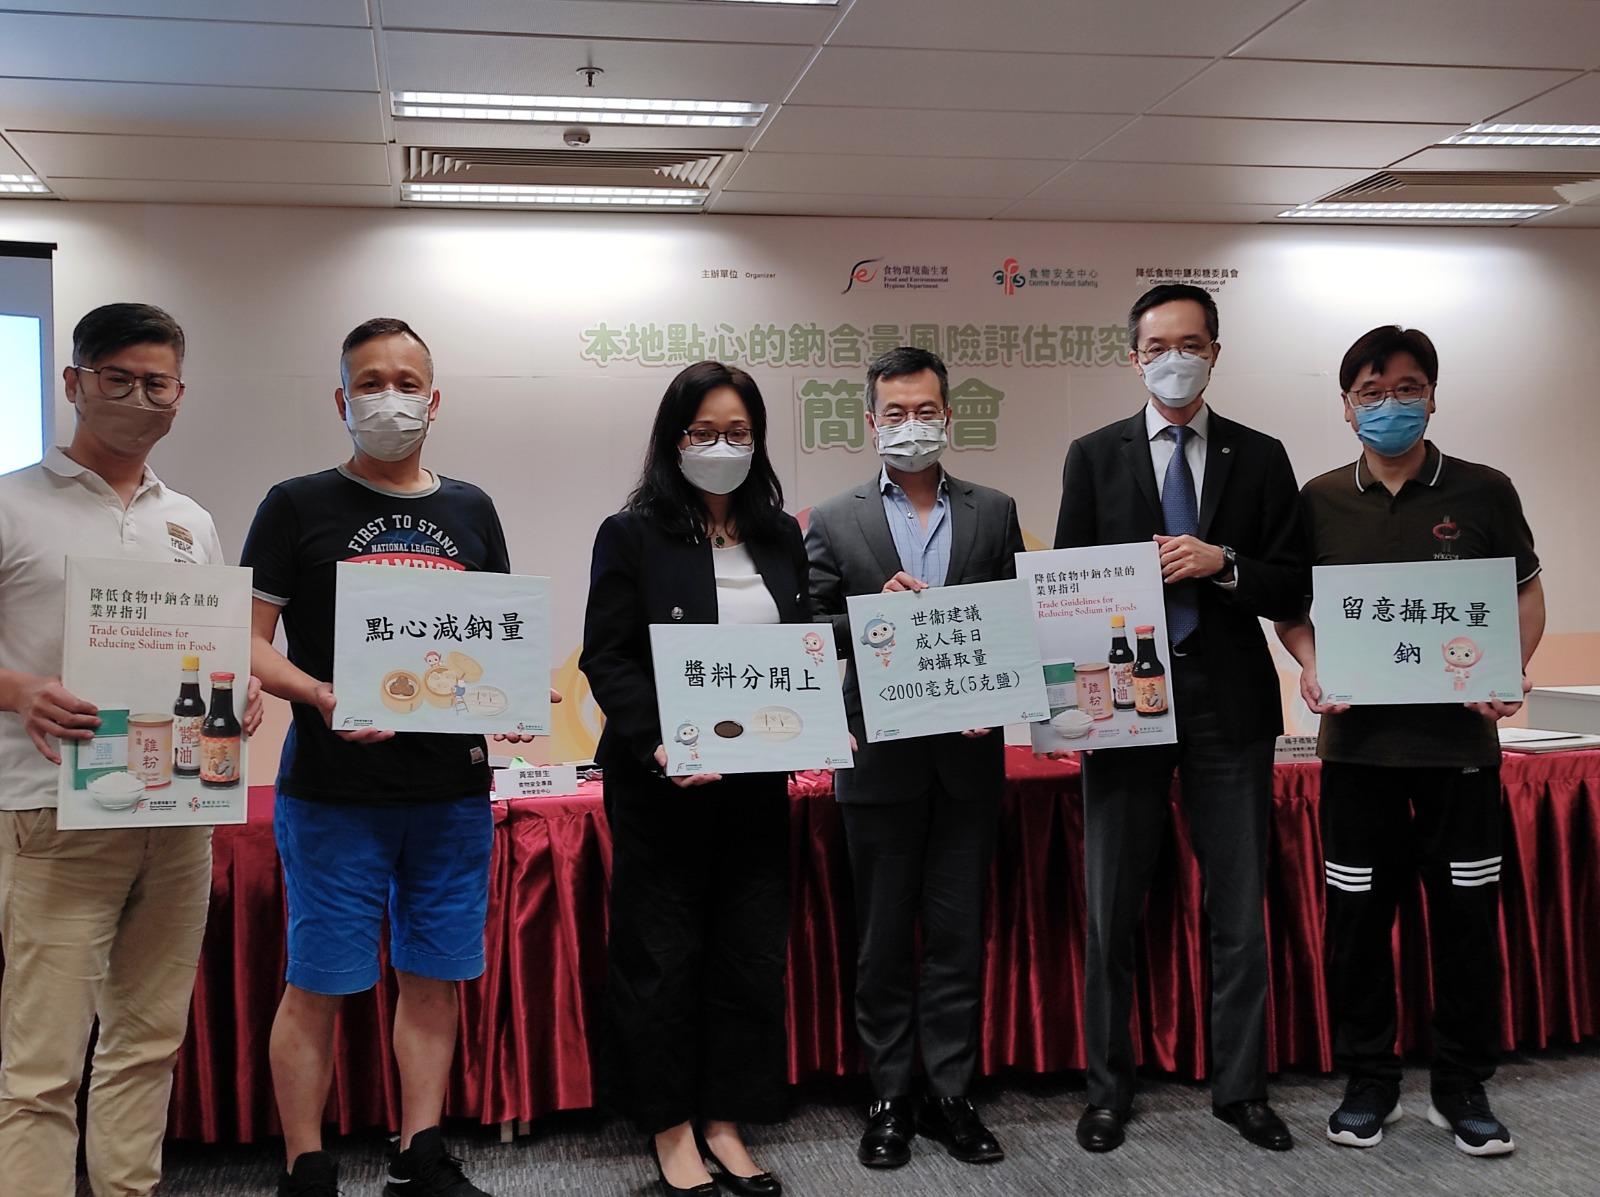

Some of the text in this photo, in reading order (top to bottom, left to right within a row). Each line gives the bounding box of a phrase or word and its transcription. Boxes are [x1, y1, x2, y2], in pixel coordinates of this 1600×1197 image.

[701, 269, 738, 280] 主辦單位
[745, 272, 776, 280] Organizer
[1029, 268, 1098, 279] 食物安全中心
[1029, 279, 1098, 288] Centre for Food Safety
[348, 514, 459, 557] FIRST TO STAND
[371, 543, 440, 556] NATIONAL LEAGUE
[1034, 565, 1135, 584] 降低食物中鈉含量的
[1037, 583, 1080, 596] 業界指引
[90, 588, 219, 608] 降低食物中鈉含量的
[1037, 596, 1114, 609] Trade Guidelines for
[90, 604, 147, 620] 業界指引
[1038, 609, 1073, 619] Reducing
[1075, 607, 1103, 616] Sodium
[1115, 603, 1137, 612] Foods
[1342, 596, 1491, 627] 留意攝取量
[89, 625, 189, 638] Trade Guidelines for
[366, 612, 524, 643] 點心減鈉量
[89, 637, 216, 652] Reducing Sodium in Foods
[915, 628, 982, 650] 成人每日
[917, 648, 987, 672] 鈉攝取量
[1393, 641, 1421, 665] 鈉
[684, 659, 821, 692] 醬料分開上
